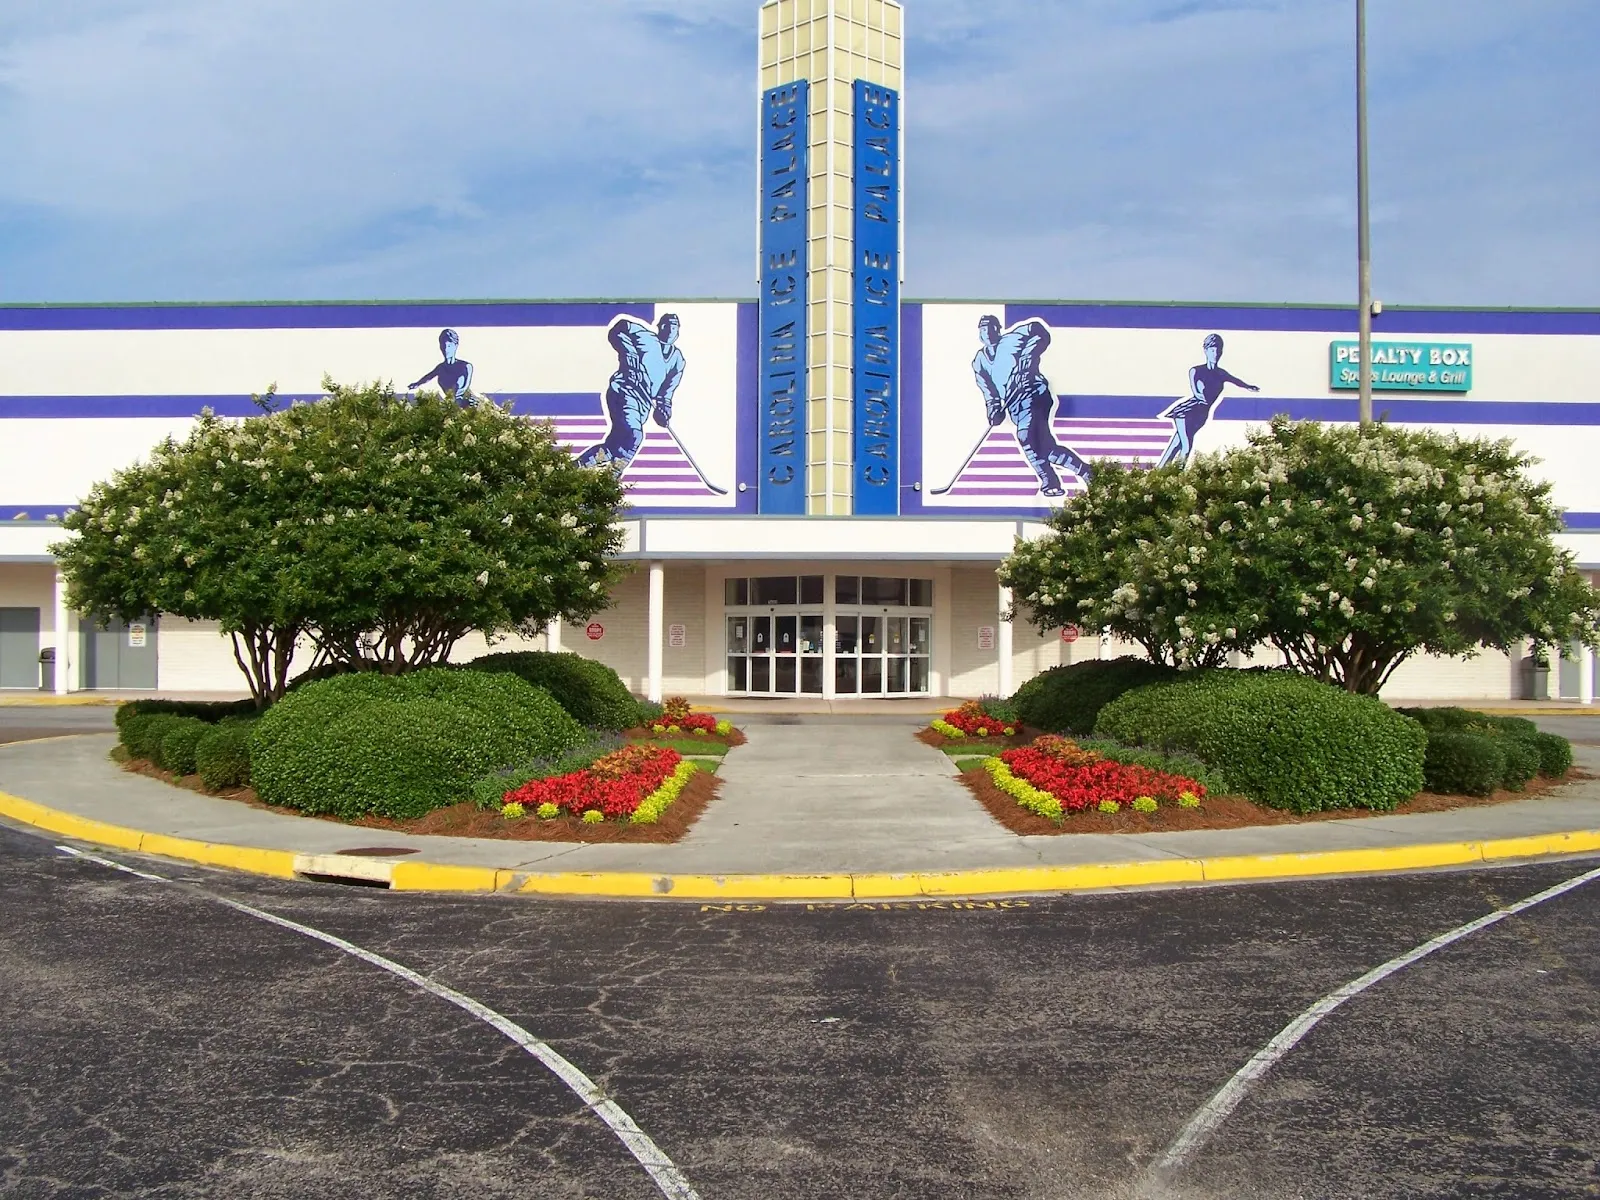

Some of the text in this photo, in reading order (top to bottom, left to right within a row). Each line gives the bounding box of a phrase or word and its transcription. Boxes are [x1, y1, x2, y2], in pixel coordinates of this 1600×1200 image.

[768, 84, 797, 486] CAROLINA ICE PALACE
[863, 85, 891, 486] CAROLINA ICE PALACE
[1336, 346, 1470, 366] PEALTY BOX
[1382, 369, 1425, 386] Lounge
[1428, 371, 1438, 383] &
[1440, 371, 1467, 385] Grill
[700, 904, 767, 912] NO
